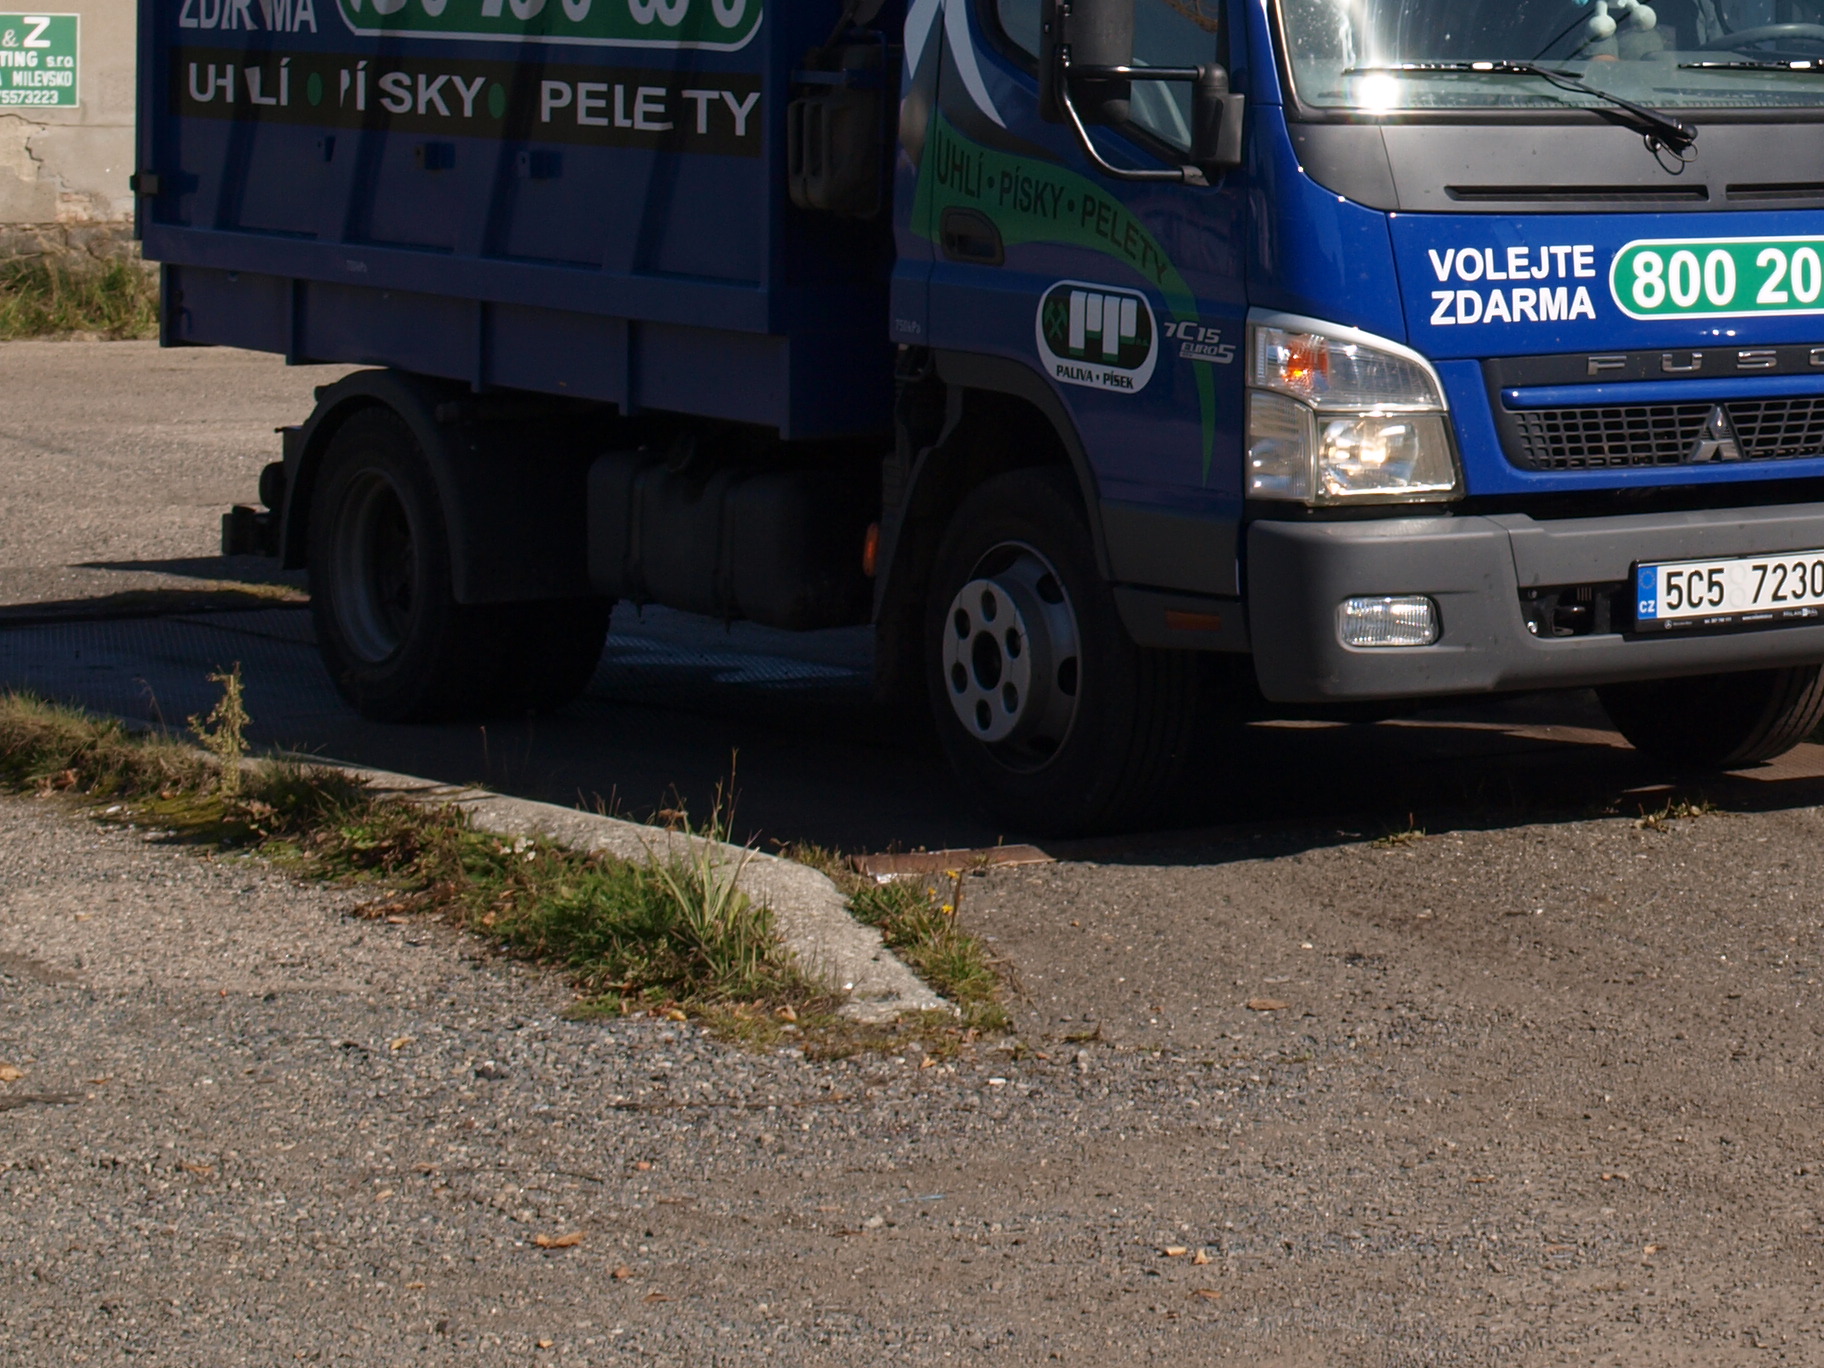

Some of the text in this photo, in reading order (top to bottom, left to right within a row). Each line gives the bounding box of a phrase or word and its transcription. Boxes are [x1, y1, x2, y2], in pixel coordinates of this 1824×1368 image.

[23, 16, 51, 48] Z
[0, 89, 59, 104] 5573223
[12, 70, 73, 87] MILEVSKO
[541, 80, 761, 136] PELETY
[936, 130, 1167, 284] UHLÍ PÍSKY PELETY
[1428, 244, 1596, 282] VOLEJTE
[1631, 249, 1736, 308] 800
[1430, 287, 1596, 326] ZDARMA
[1164, 321, 1222, 344] 7C15
[1056, 365, 1134, 390] PALIVA PÍSEK
[1639, 600, 1656, 614] CZ
[1666, 567, 1725, 610] 5C5
